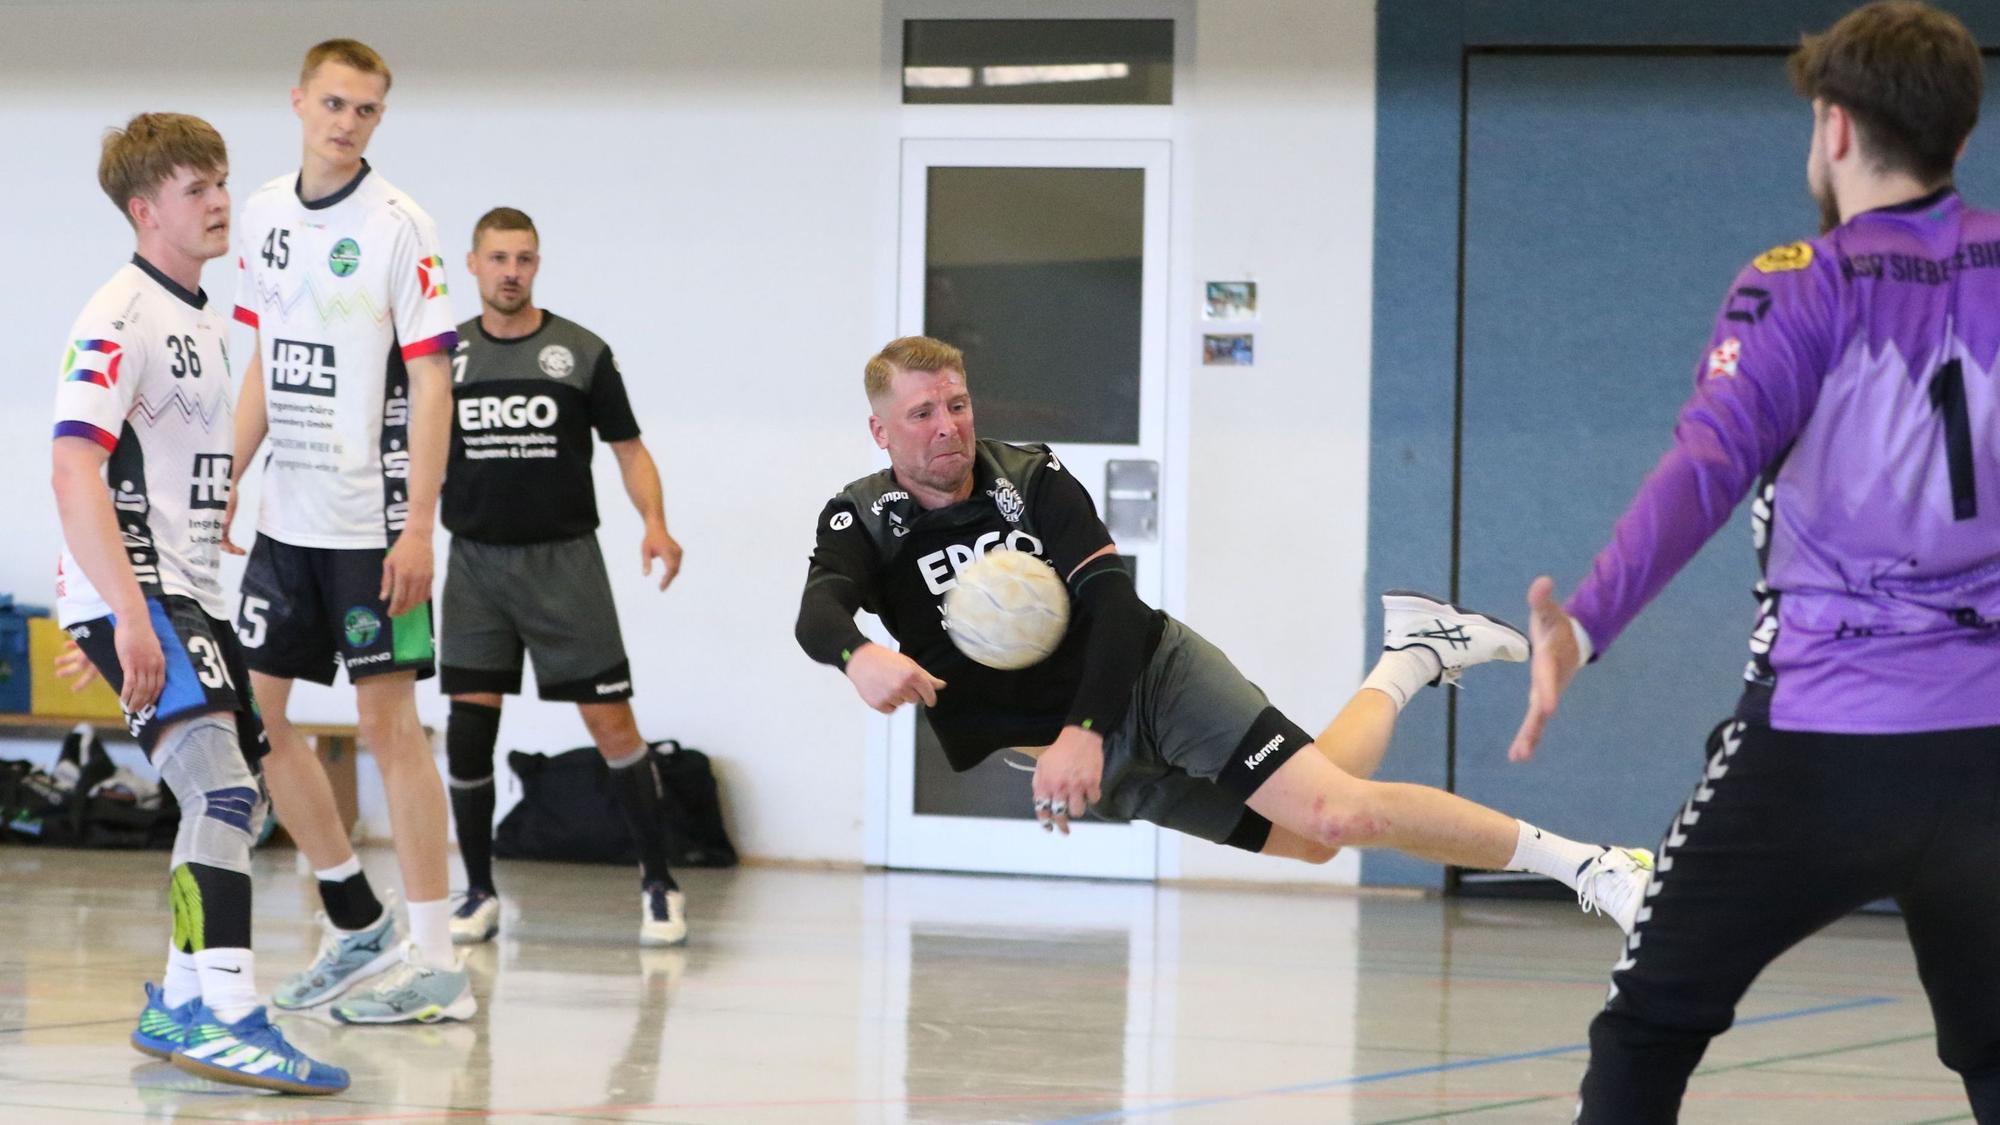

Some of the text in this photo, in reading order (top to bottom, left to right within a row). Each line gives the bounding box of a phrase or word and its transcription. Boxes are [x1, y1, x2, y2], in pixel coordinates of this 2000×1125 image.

[262, 227, 291, 270] 45
[166, 335, 202, 379] 36
[458, 395, 559, 431] ERGO
[1929, 357, 1977, 521] 1
[187, 635, 236, 691] 3
[1244, 733, 1285, 770] Kempa
